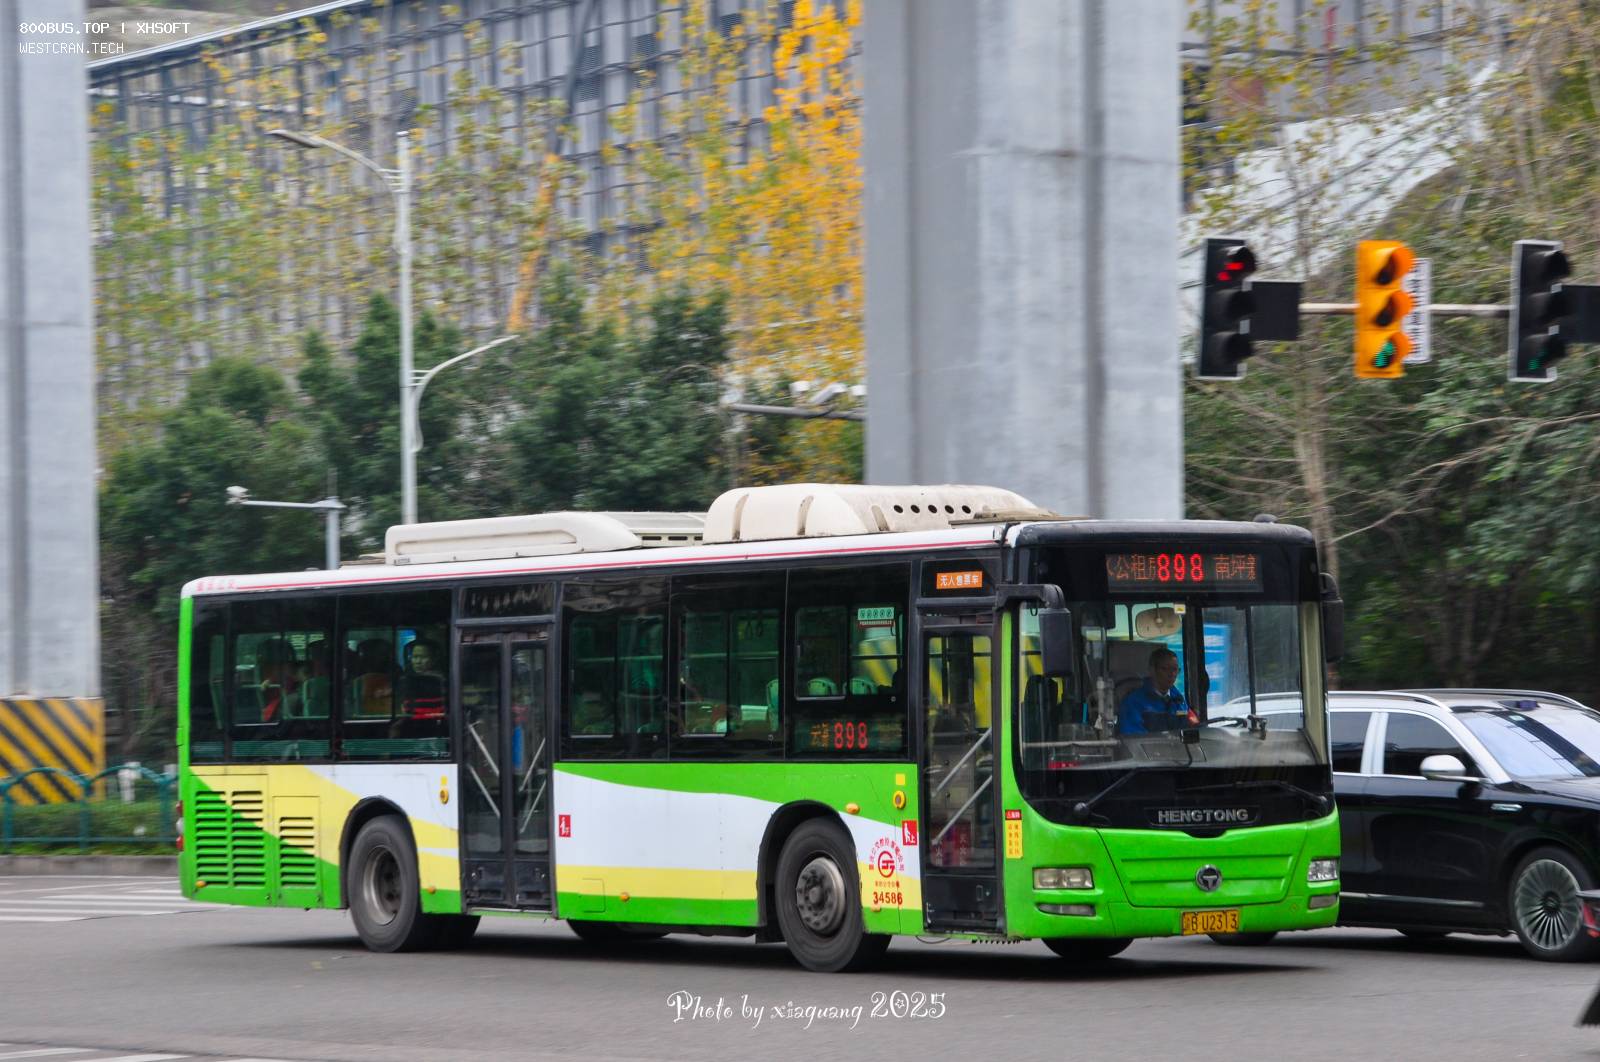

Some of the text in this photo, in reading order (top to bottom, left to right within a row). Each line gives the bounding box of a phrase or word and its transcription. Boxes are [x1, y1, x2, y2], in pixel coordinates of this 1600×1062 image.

[1157, 553, 1204, 581] 898
[834, 721, 868, 749] 898
[1158, 809, 1248, 822] HENGTONG
[873, 891, 903, 906] 34586
